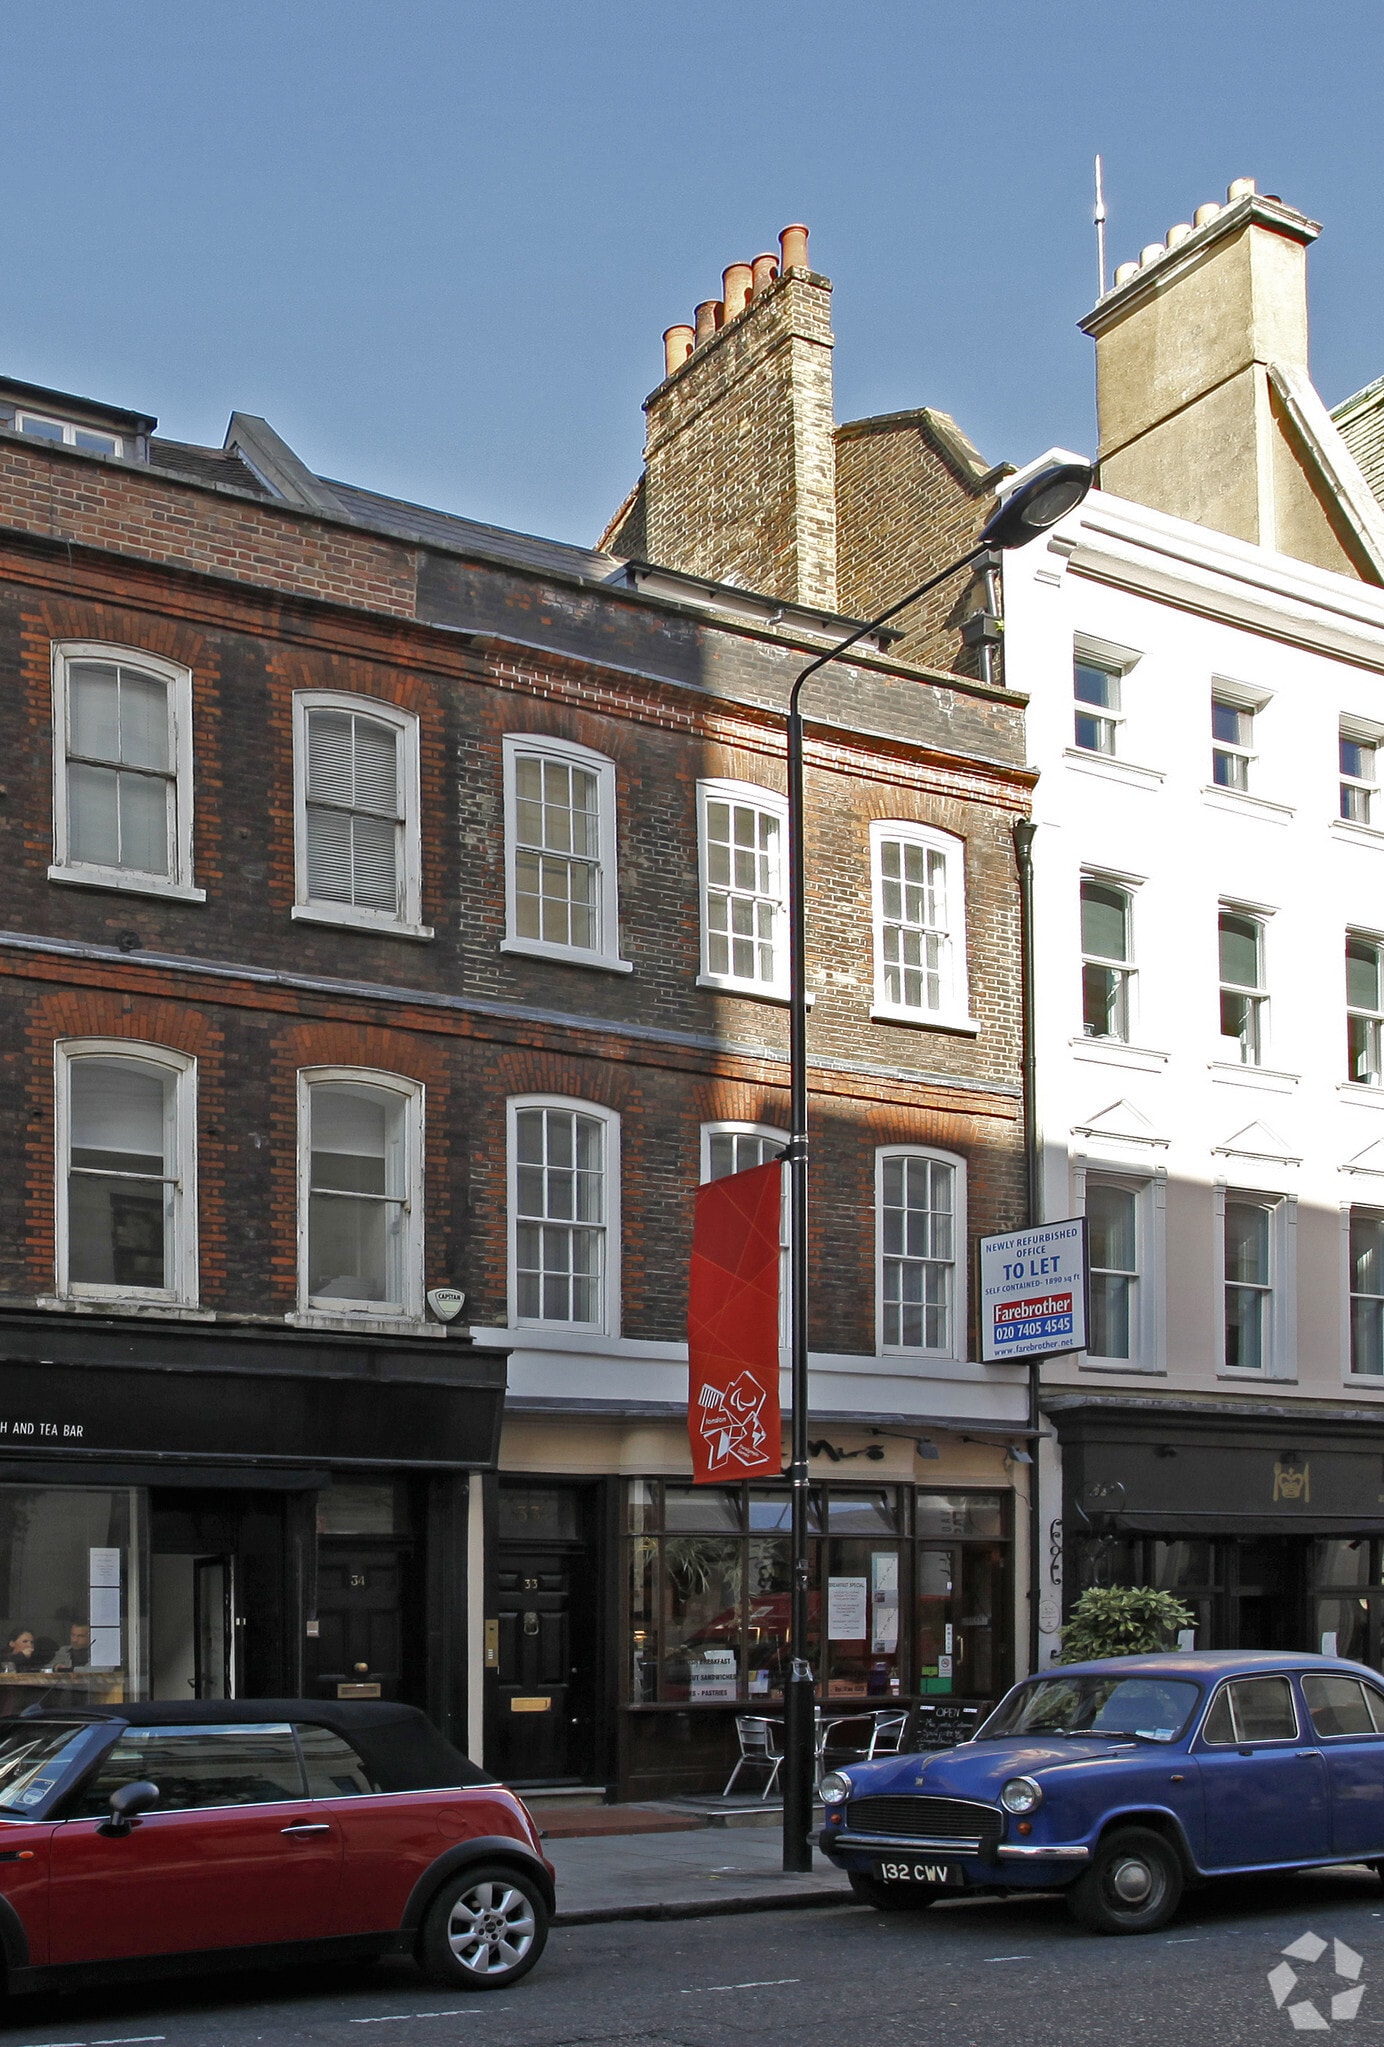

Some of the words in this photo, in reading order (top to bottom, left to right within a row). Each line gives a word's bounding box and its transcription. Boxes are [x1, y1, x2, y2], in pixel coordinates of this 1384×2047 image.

[986, 1240, 1014, 1253] NEWLY
[1016, 1228, 1078, 1247] REFURBISHED
[1016, 1245, 1046, 1258] OFFICE
[1003, 1262, 1025, 1281] TO
[1030, 1255, 1060, 1276] LET
[985, 1285, 1001, 1296] SELF
[1045, 1276, 1062, 1285] 1890
[1063, 1274, 1072, 1283] sq
[1073, 1273, 1080, 1281] ft
[995, 1297, 1070, 1322] Farebrother
[996, 1326, 1014, 1340] 020
[1017, 1321, 1042, 1337] 7405
[1044, 1317, 1070, 1333] 4545
[994, 1338, 1074, 1356] www.farebrother.net
[12, 1422, 35, 1435] AND
[40, 1423, 58, 1436] TEA
[63, 1424, 84, 1437] BAR
[351, 1575, 365, 1586] 34
[524, 1579, 538, 1589] 33
[700, 1673, 738, 1681] SANDWICHES
[701, 1689, 728, 1697] PASTRIES
[935, 1707, 961, 1719] OPEN
[881, 1863, 910, 1880] 132
[914, 1864, 947, 1882] CWV
